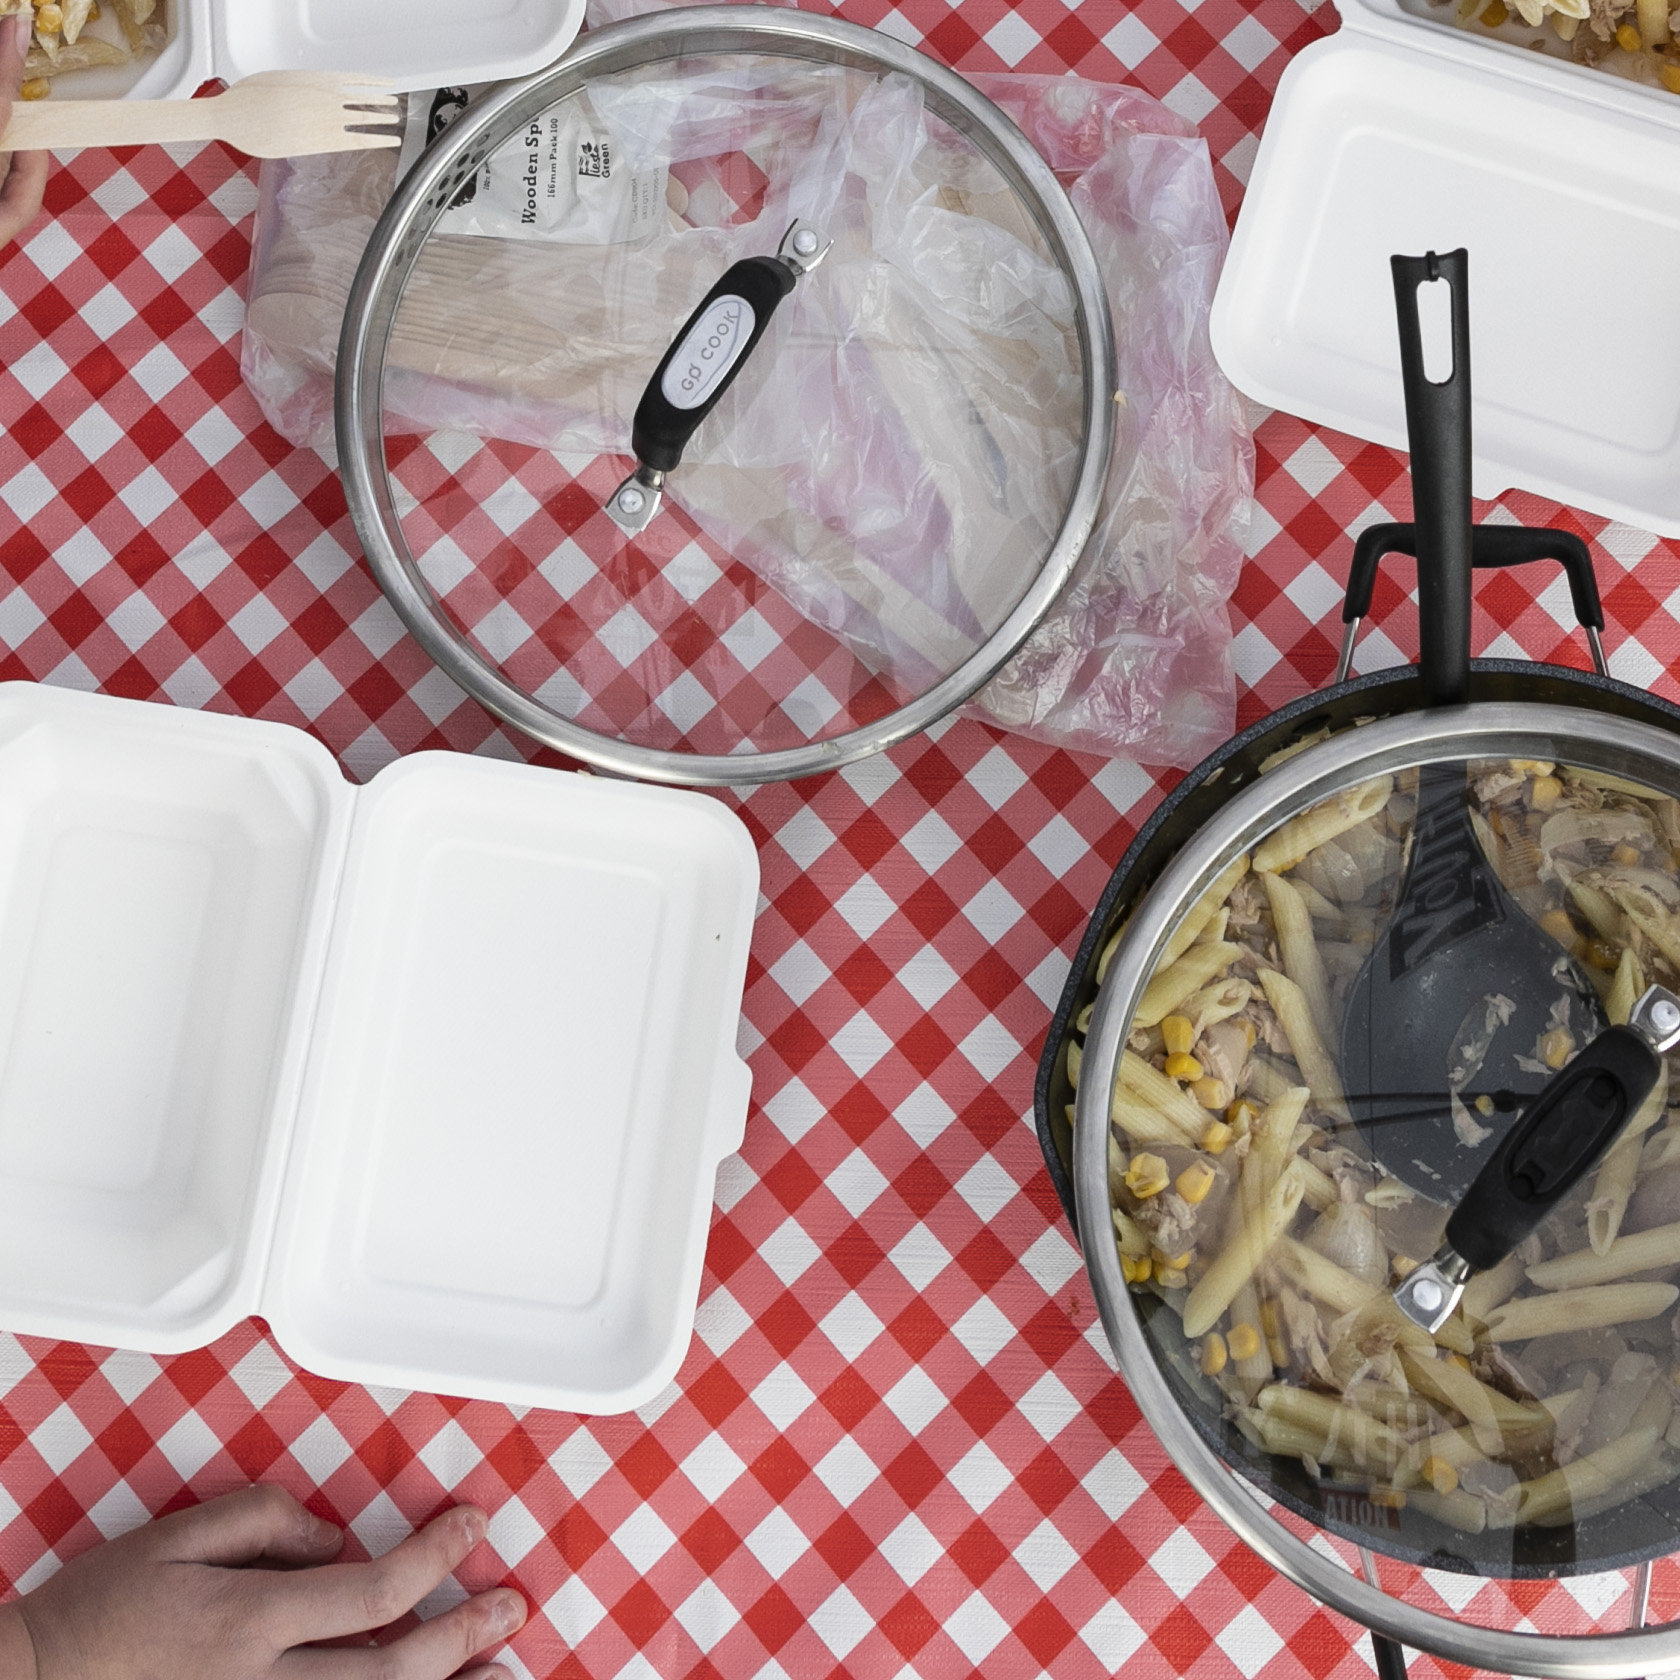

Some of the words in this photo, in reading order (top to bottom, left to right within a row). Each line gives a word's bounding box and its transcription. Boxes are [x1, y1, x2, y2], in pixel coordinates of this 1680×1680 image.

[549, 118, 558, 133] 100
[549, 135, 558, 160] Pack
[578, 144, 601, 178] Fiesta
[601, 143, 611, 178] Green
[521, 153, 538, 224] Wooden
[547, 162, 557, 198] 166mm
[701, 310, 739, 360] COOK
